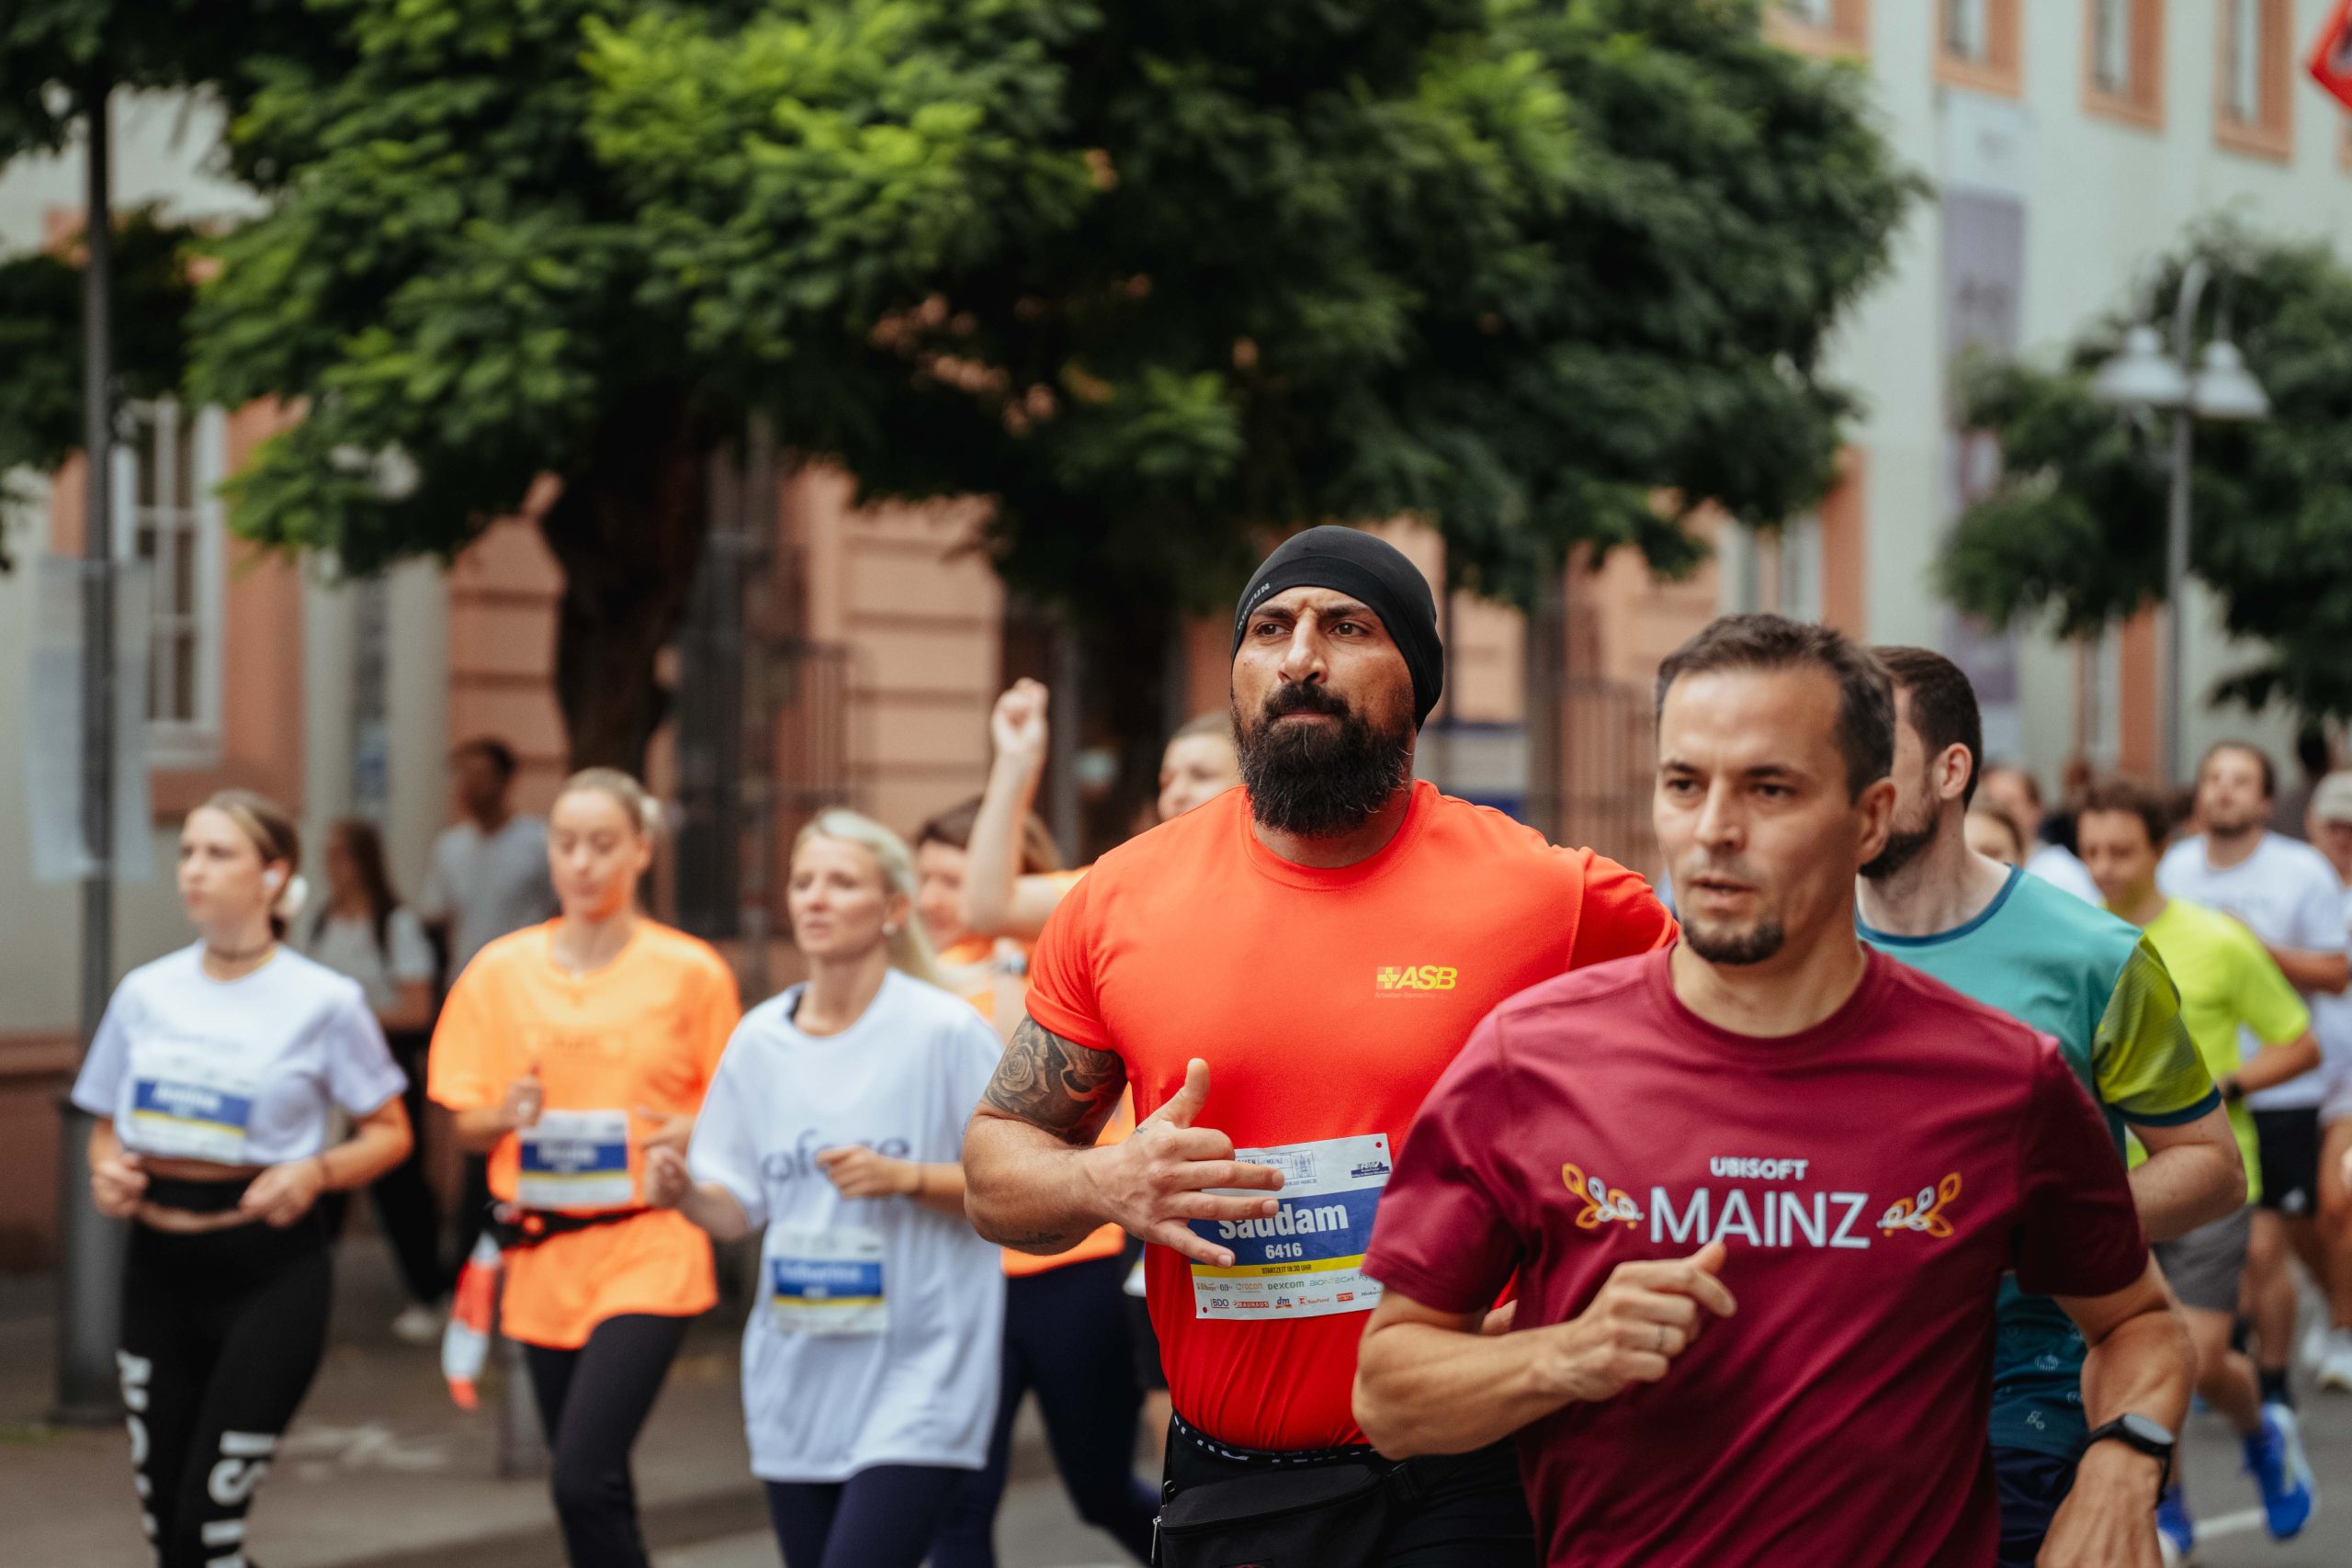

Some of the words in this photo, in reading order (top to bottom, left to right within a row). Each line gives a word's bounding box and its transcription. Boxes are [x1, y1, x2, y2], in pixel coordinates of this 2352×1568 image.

[1395, 964, 1458, 990] ASB
[1710, 1156, 1809, 1181] UBISOFT
[1650, 1186, 1871, 1249] MAINZ
[1265, 1242, 1303, 1259] 6416
[1212, 1298, 1229, 1307] BDO
[1276, 1296, 1290, 1305] dm
